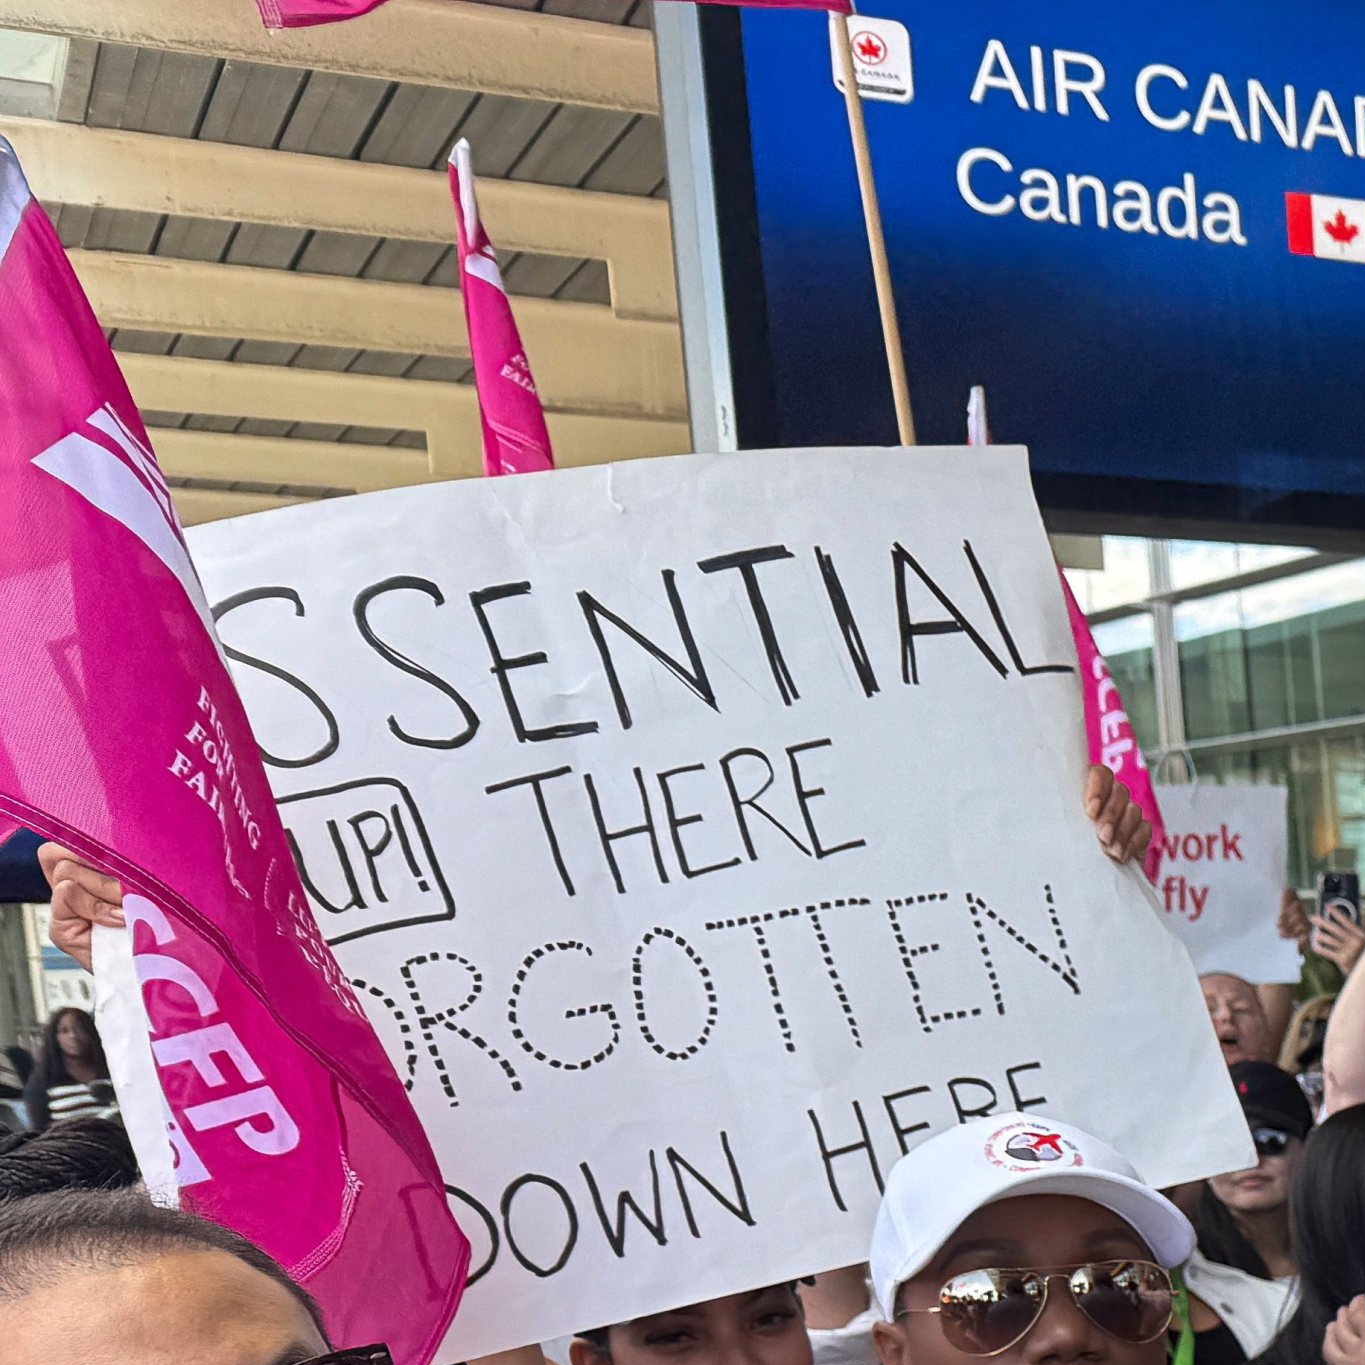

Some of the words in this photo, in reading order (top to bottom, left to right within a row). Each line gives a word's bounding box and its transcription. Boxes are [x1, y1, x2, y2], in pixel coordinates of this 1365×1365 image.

[969, 40, 1110, 123] AIR
[956, 147, 1247, 247] Canada
[213, 540, 1076, 769] SSENTIAL
[283, 803, 433, 914] UP!
[486, 738, 866, 897] THERE
[1162, 876, 1210, 922] fly
[352, 883, 1081, 1106] RGOTTEN
